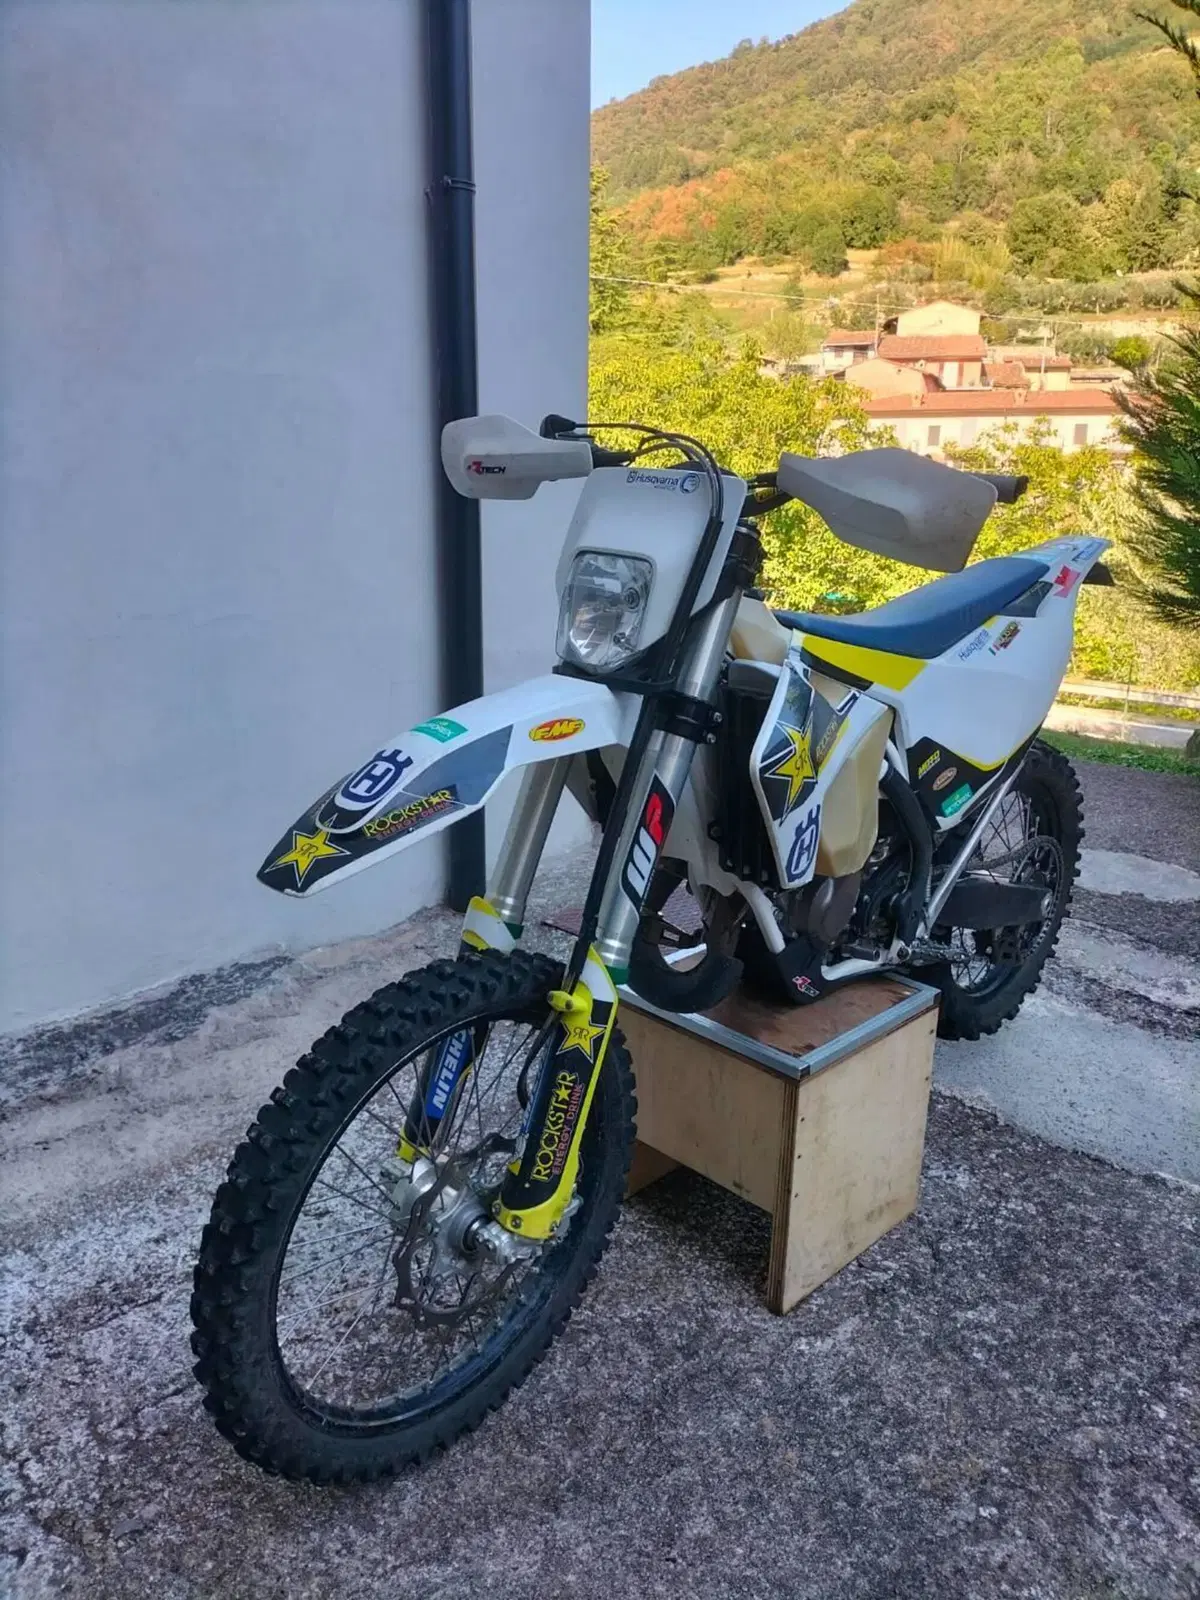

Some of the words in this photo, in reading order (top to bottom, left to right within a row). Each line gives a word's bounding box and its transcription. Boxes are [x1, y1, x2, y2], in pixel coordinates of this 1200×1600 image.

[531, 719, 585, 741] FMF
[432, 1029, 467, 1110] CHELIN
[552, 1124, 572, 1175] ENERGY
[566, 1083, 583, 1120] DRINK
